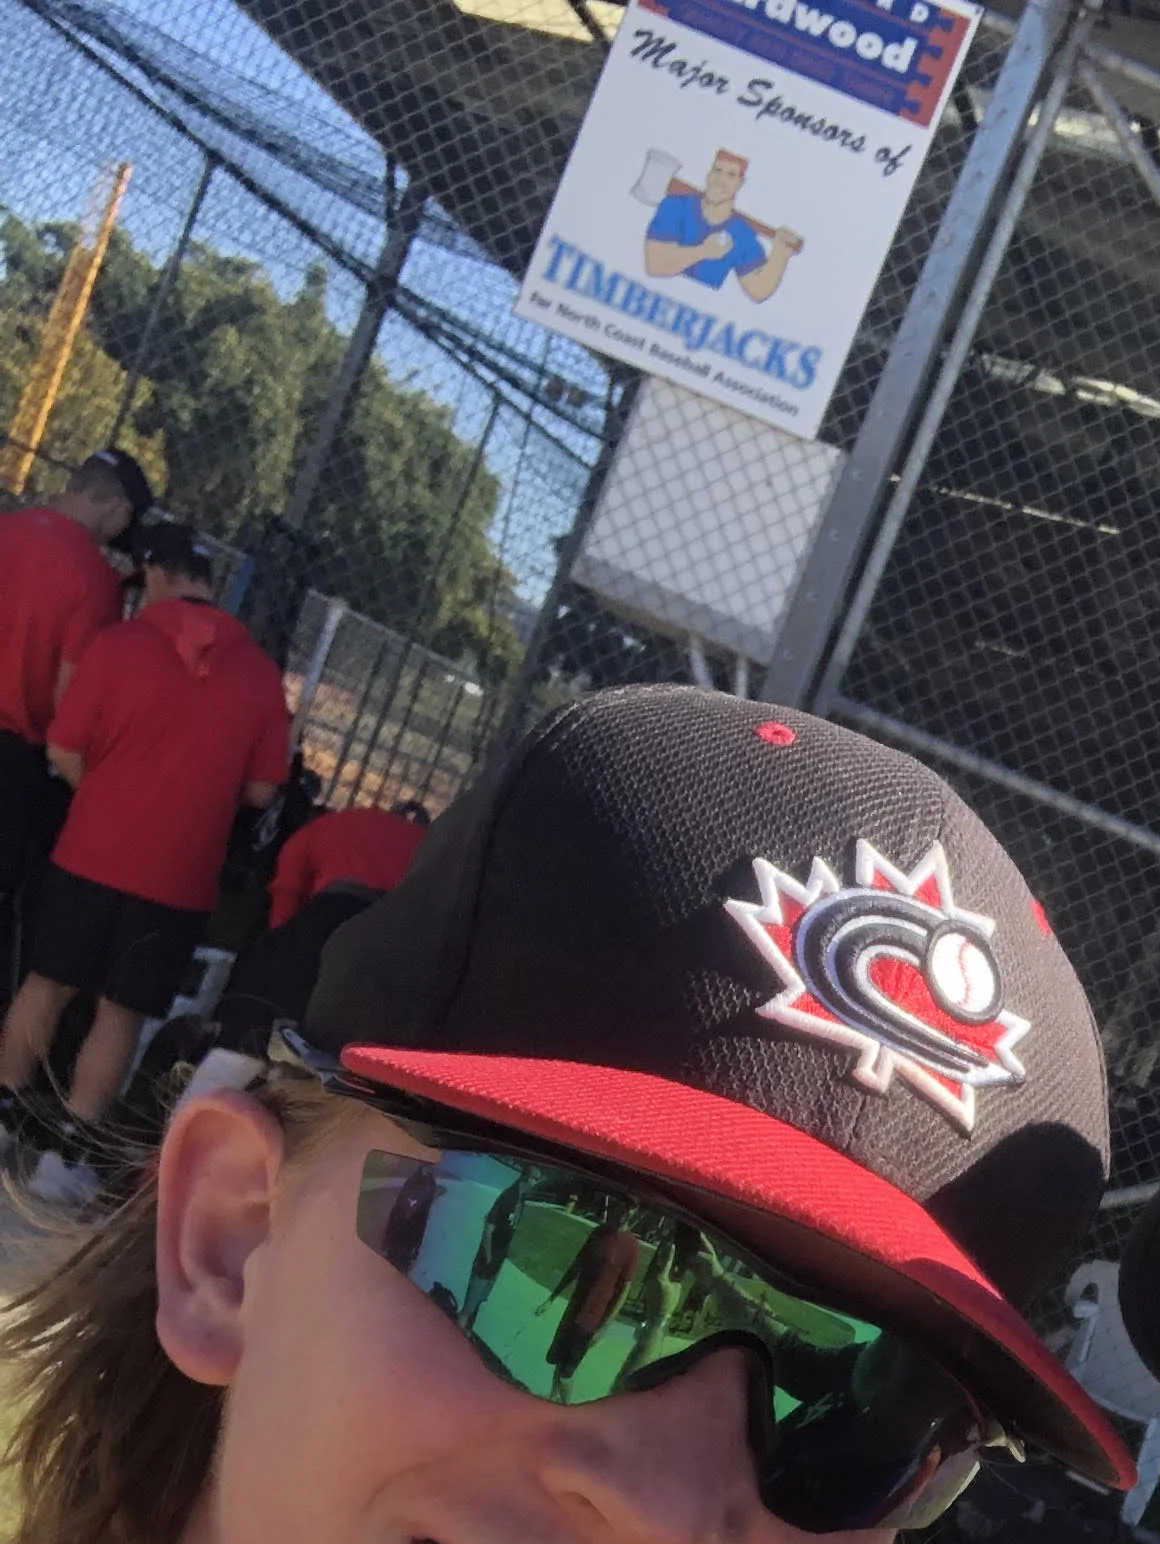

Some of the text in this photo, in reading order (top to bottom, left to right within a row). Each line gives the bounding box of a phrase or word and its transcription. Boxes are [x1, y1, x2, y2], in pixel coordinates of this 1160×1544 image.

[631, 28, 730, 94] Major
[736, 77, 867, 153] Sponsors
[875, 144, 913, 177] of
[541, 234, 823, 391] TIMBERJACKS
[555, 303, 600, 330] North
[604, 323, 646, 350] Coast
[649, 343, 712, 378] Baseball
[713, 371, 799, 417] Association
